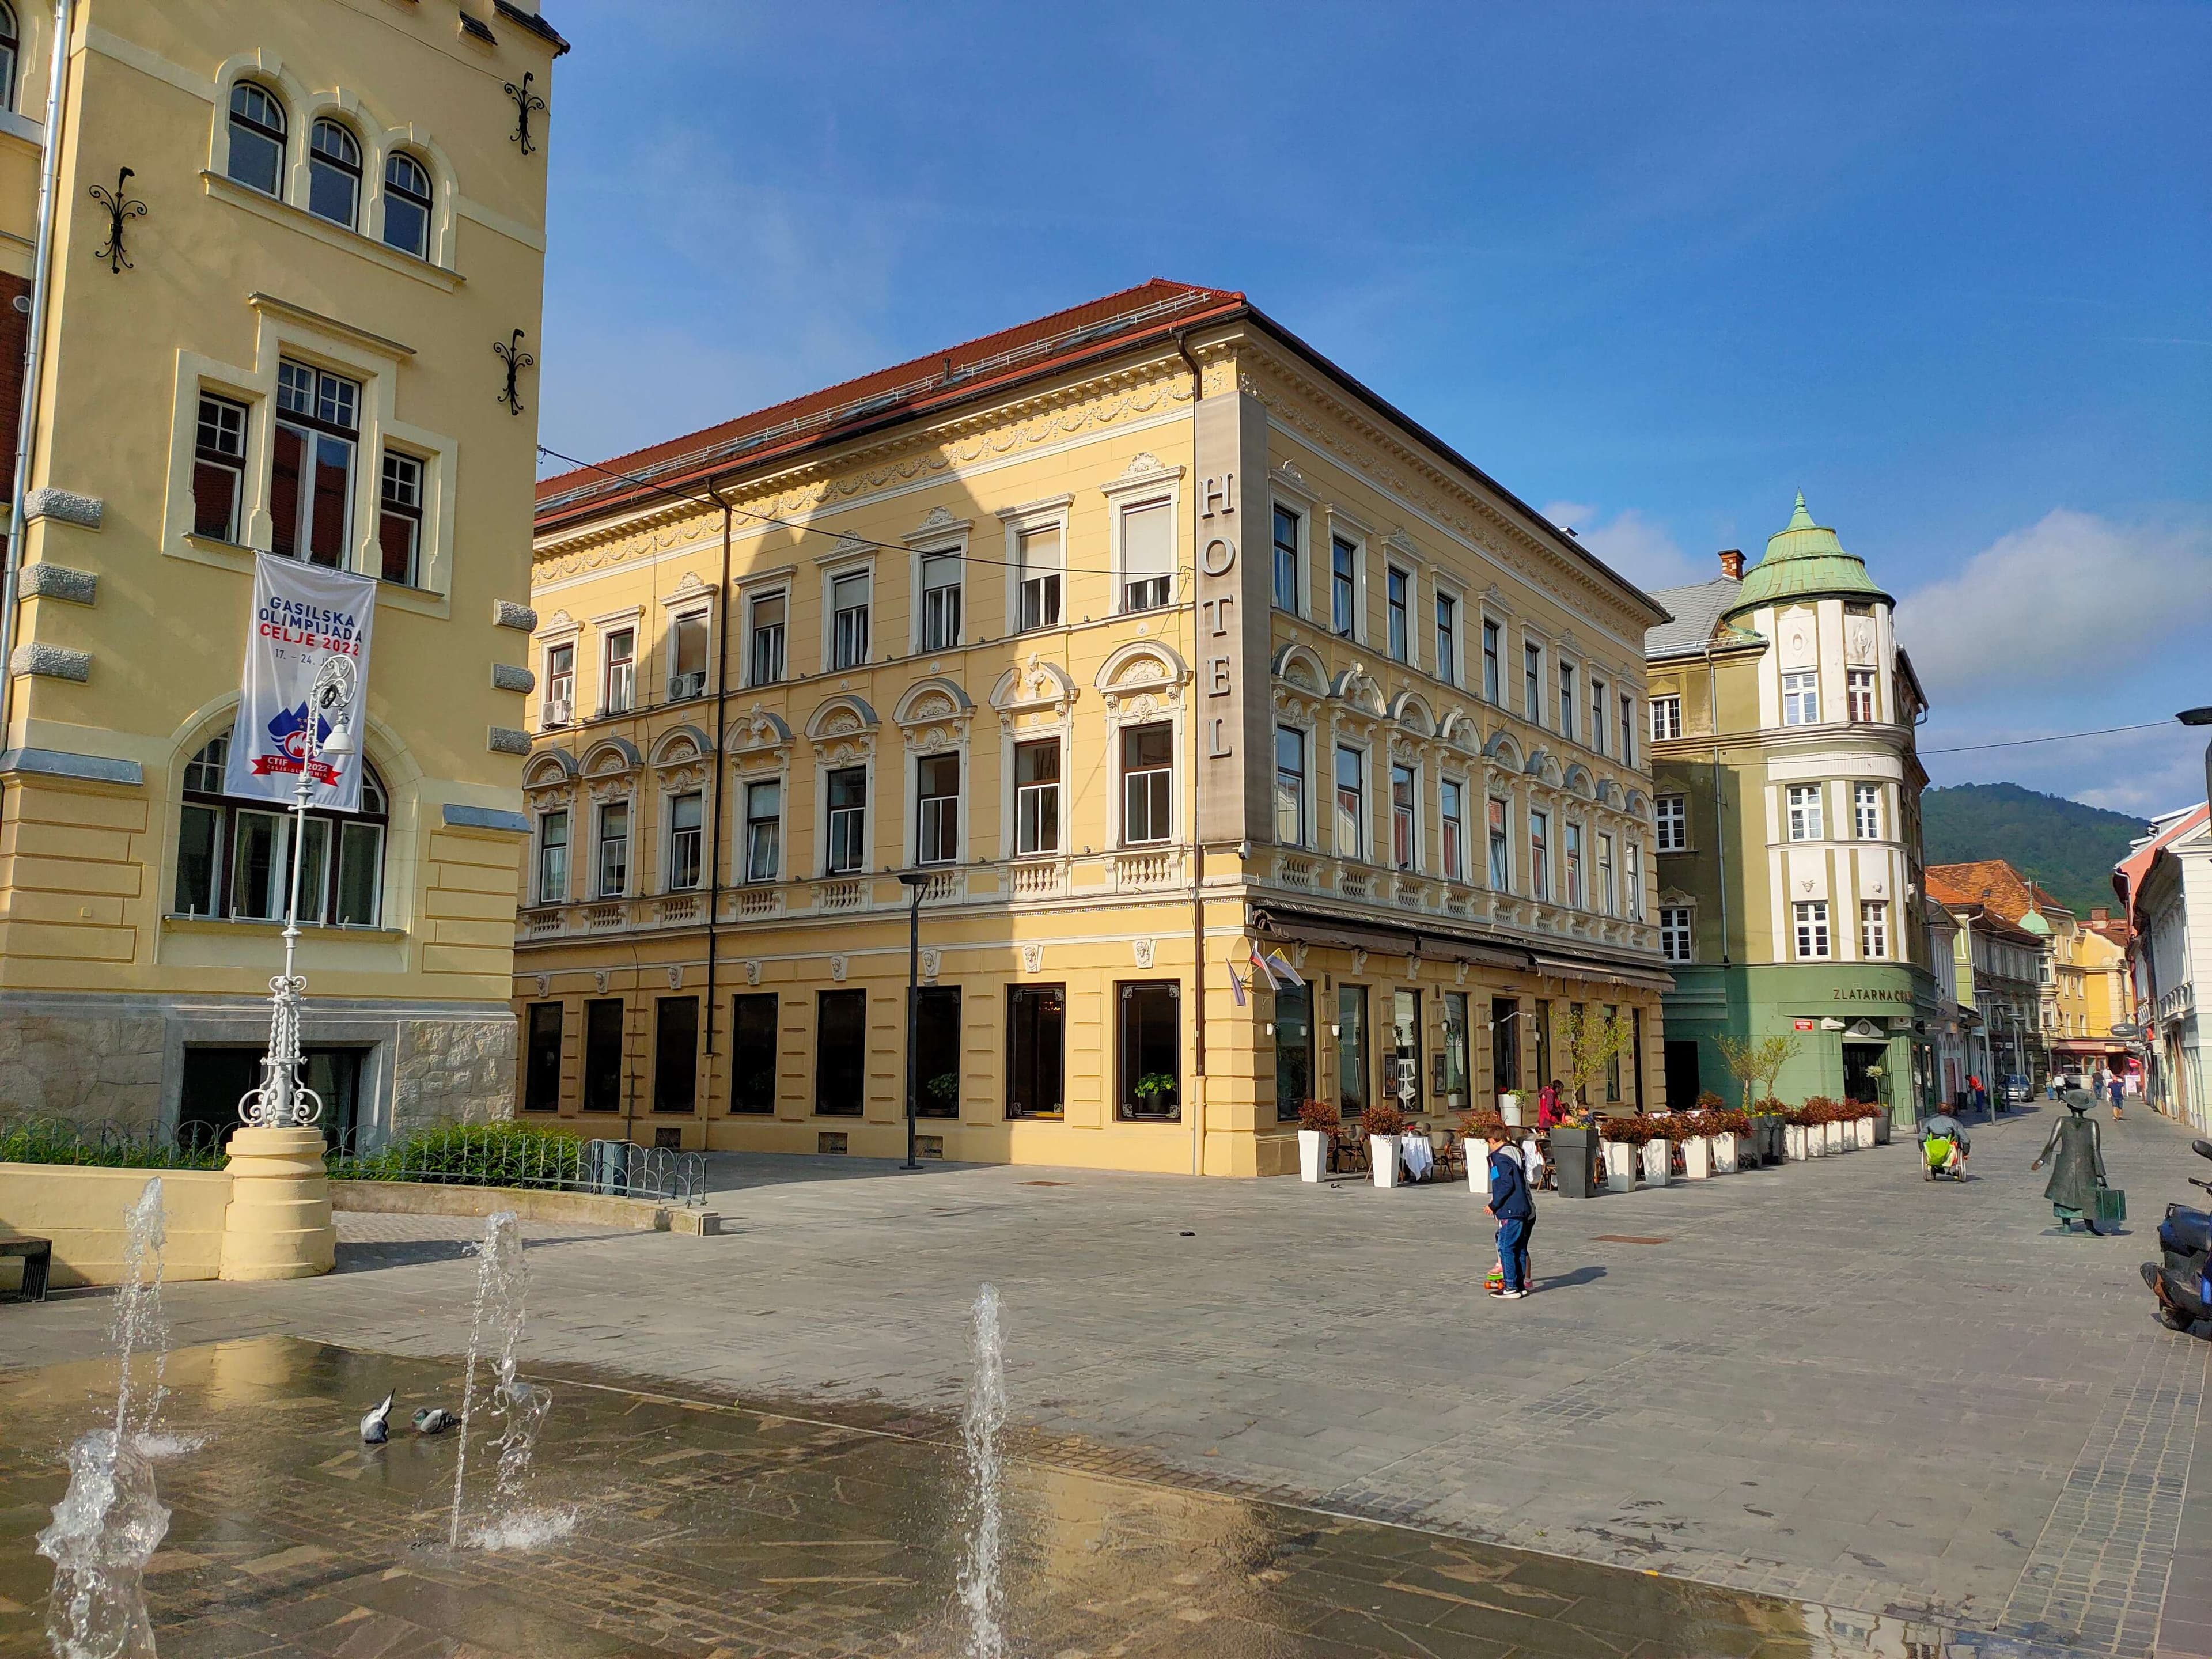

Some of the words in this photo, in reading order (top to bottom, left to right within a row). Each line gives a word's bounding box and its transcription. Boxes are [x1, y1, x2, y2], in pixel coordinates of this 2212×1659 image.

[259, 608, 362, 643] OLIMPIJADA
[270, 596, 355, 627] GASILSKA
[1200, 473, 1236, 760] HOTEL
[260, 623, 316, 646] CELJE
[322, 637, 359, 656] 2022
[275, 649, 286, 660] 17.
[301, 654, 315, 665] 24.
[267, 757, 289, 766] CTIF
[308, 763, 328, 772] 2022
[1833, 989, 1892, 1001] ZLATARNA
